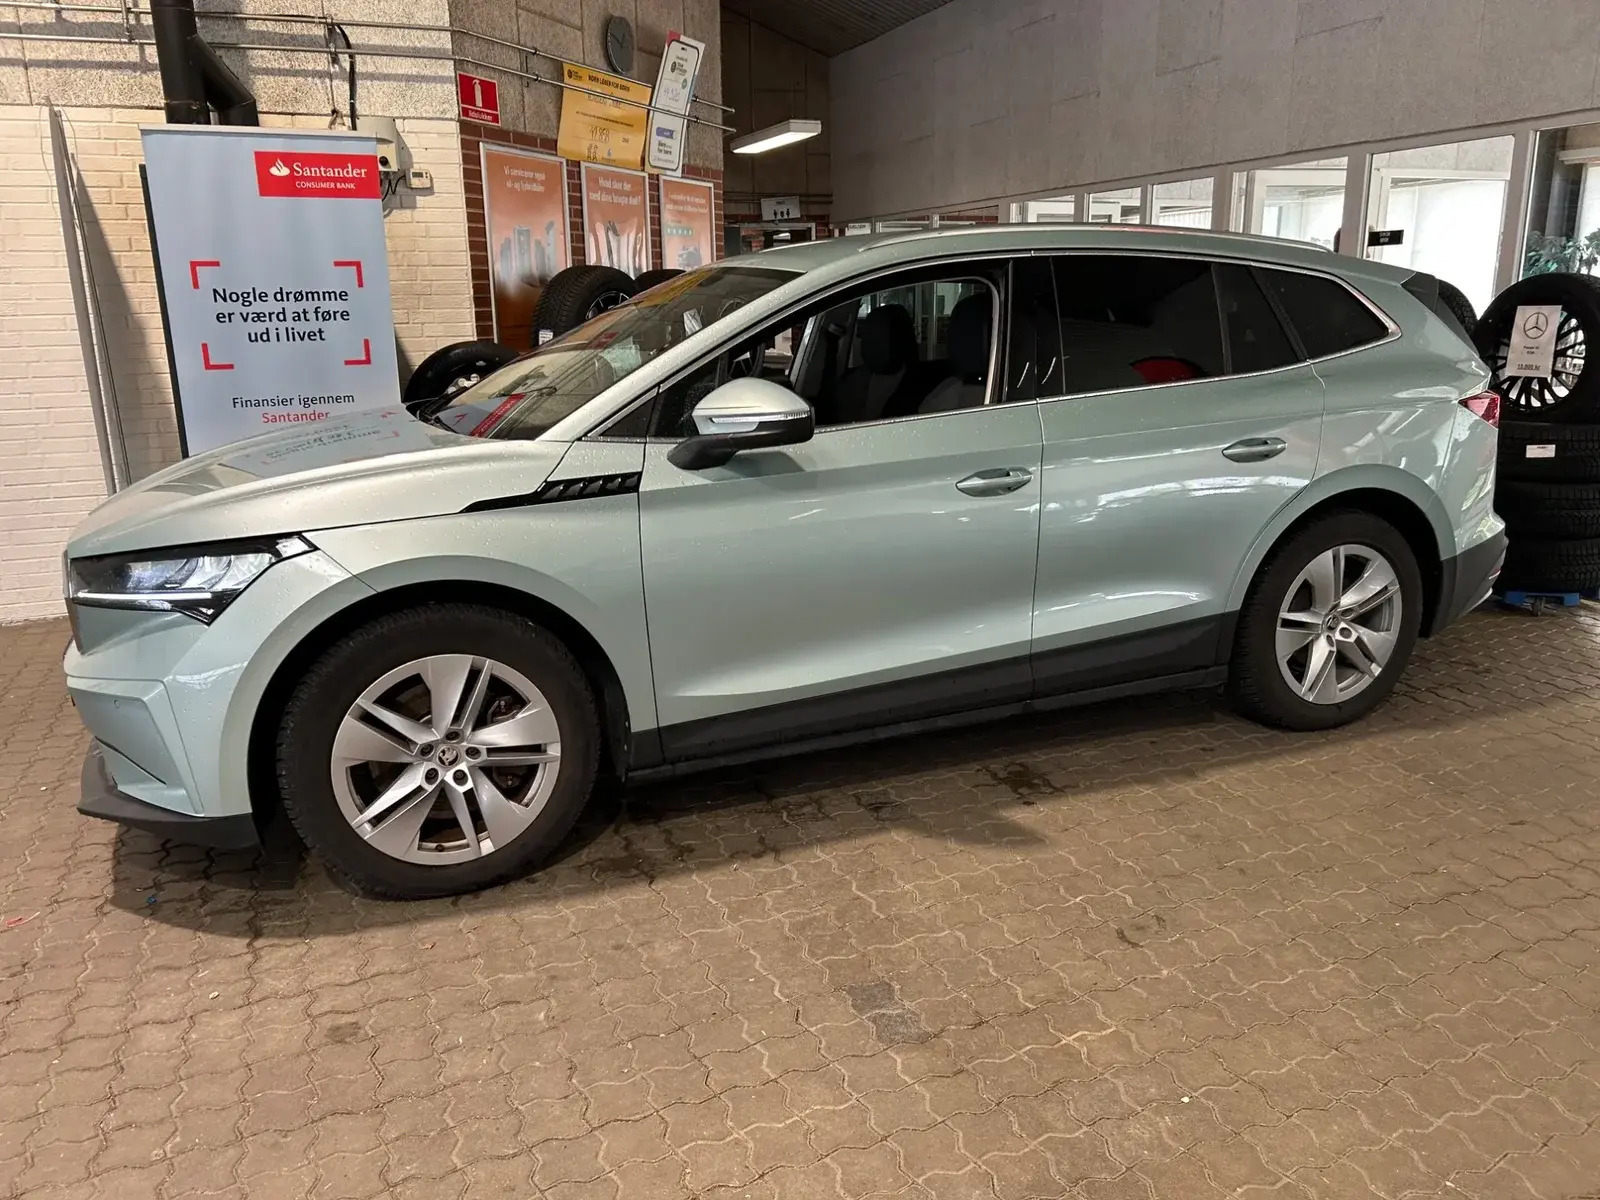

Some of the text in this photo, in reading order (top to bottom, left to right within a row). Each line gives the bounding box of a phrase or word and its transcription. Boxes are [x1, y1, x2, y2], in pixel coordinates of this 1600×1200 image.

[293, 163, 368, 178] Santander
[503, 165, 510, 175] Vi
[295, 181, 336, 189] CONSUMER
[598, 177, 611, 188] Hvad
[212, 287, 349, 307] Nogle drømme
[216, 306, 350, 323] er værd at føre
[248, 326, 326, 343] ud i livet
[232, 393, 355, 409] Finansier igennem
[261, 410, 331, 424] Santander
